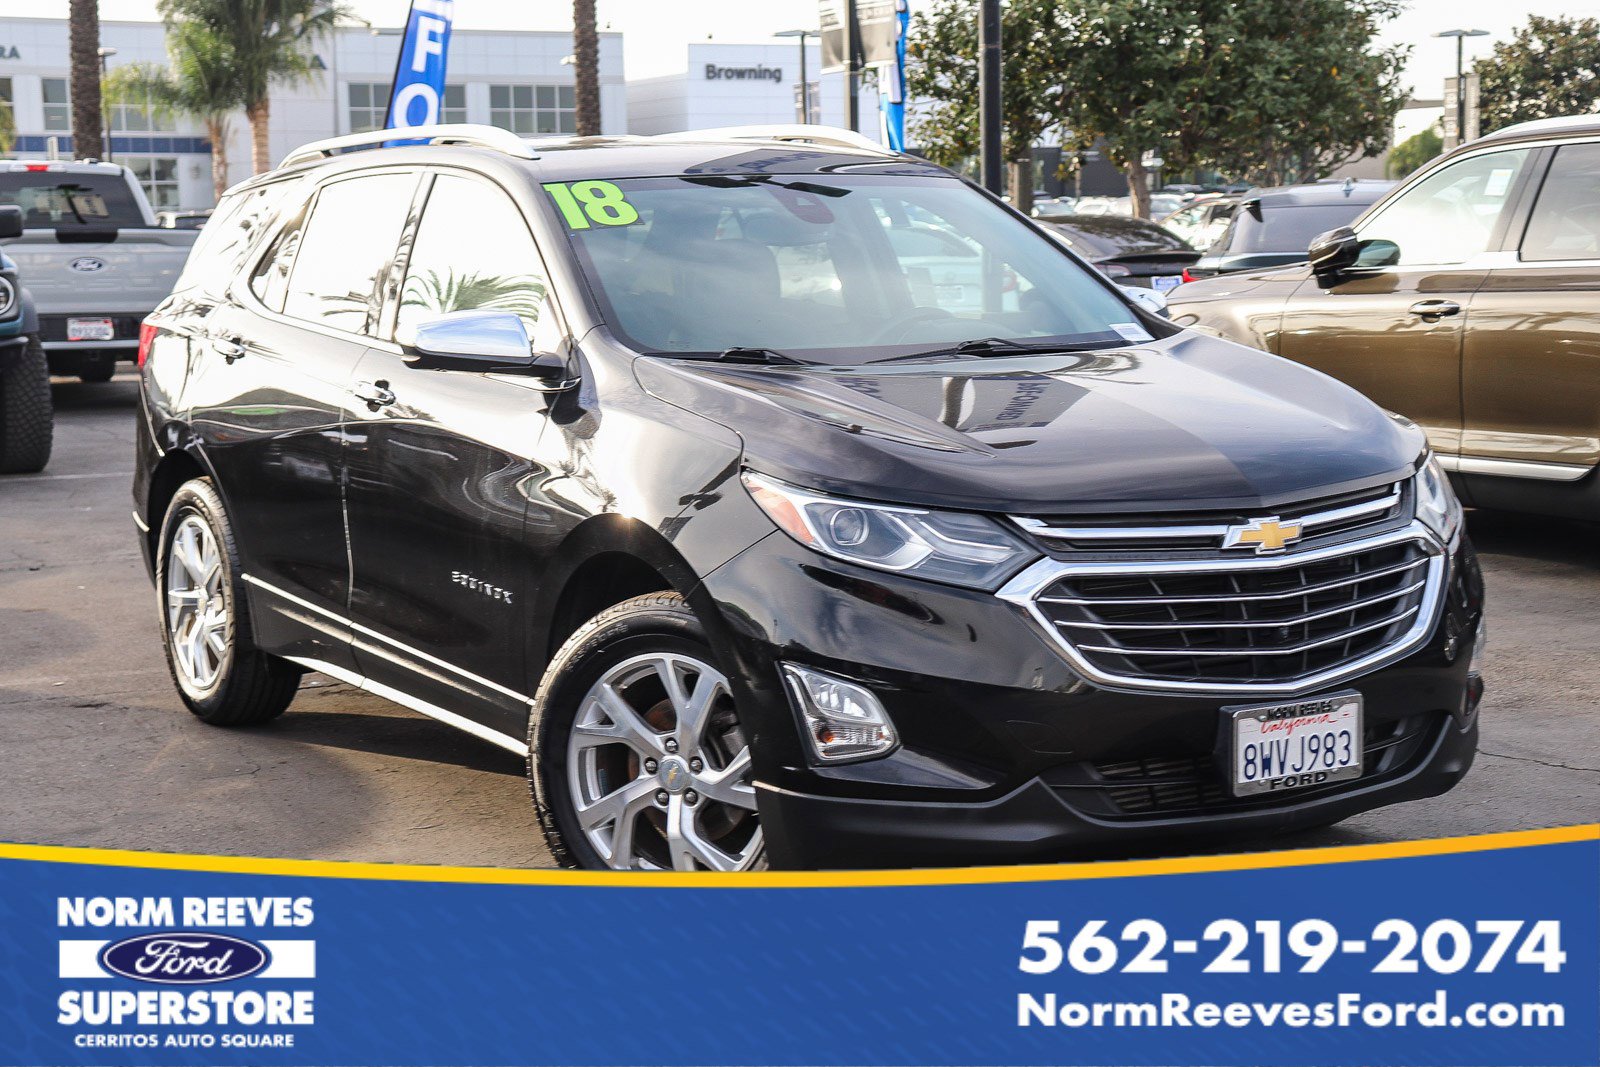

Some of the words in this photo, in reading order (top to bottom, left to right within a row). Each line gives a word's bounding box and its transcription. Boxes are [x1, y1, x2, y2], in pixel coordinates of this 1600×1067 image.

[705, 63, 782, 83] Browning
[543, 180, 639, 230] 18
[1267, 706, 1296, 720] NORM
[1300, 700, 1333, 716] REEVES
[1260, 713, 1338, 735] California
[1244, 729, 1351, 780] 8WVJ983
[1270, 771, 1327, 790] FORD
